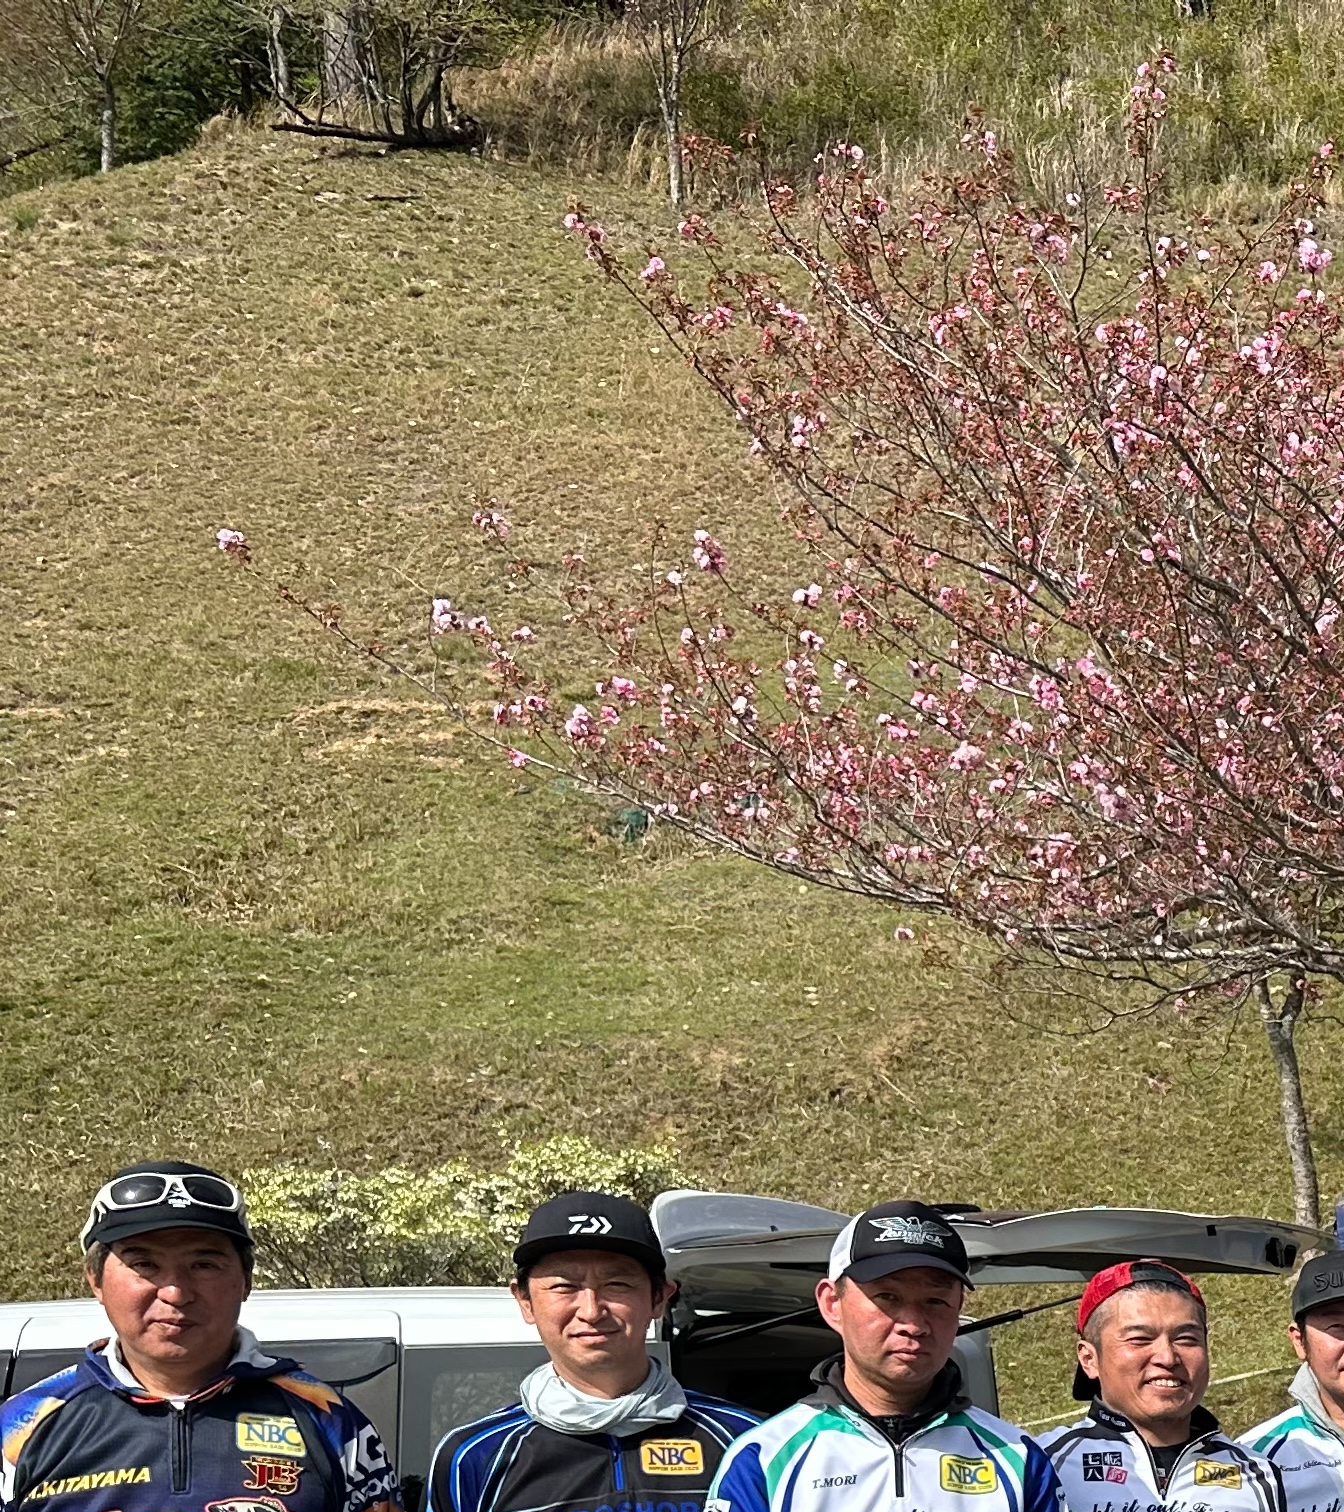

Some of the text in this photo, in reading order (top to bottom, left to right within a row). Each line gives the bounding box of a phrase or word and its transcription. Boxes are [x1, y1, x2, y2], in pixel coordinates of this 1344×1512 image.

[245, 1423, 300, 1446] NBC
[648, 1447, 698, 1466] NBC
[812, 1475, 857, 1489] T.MORI
[947, 1463, 991, 1485] NBC
